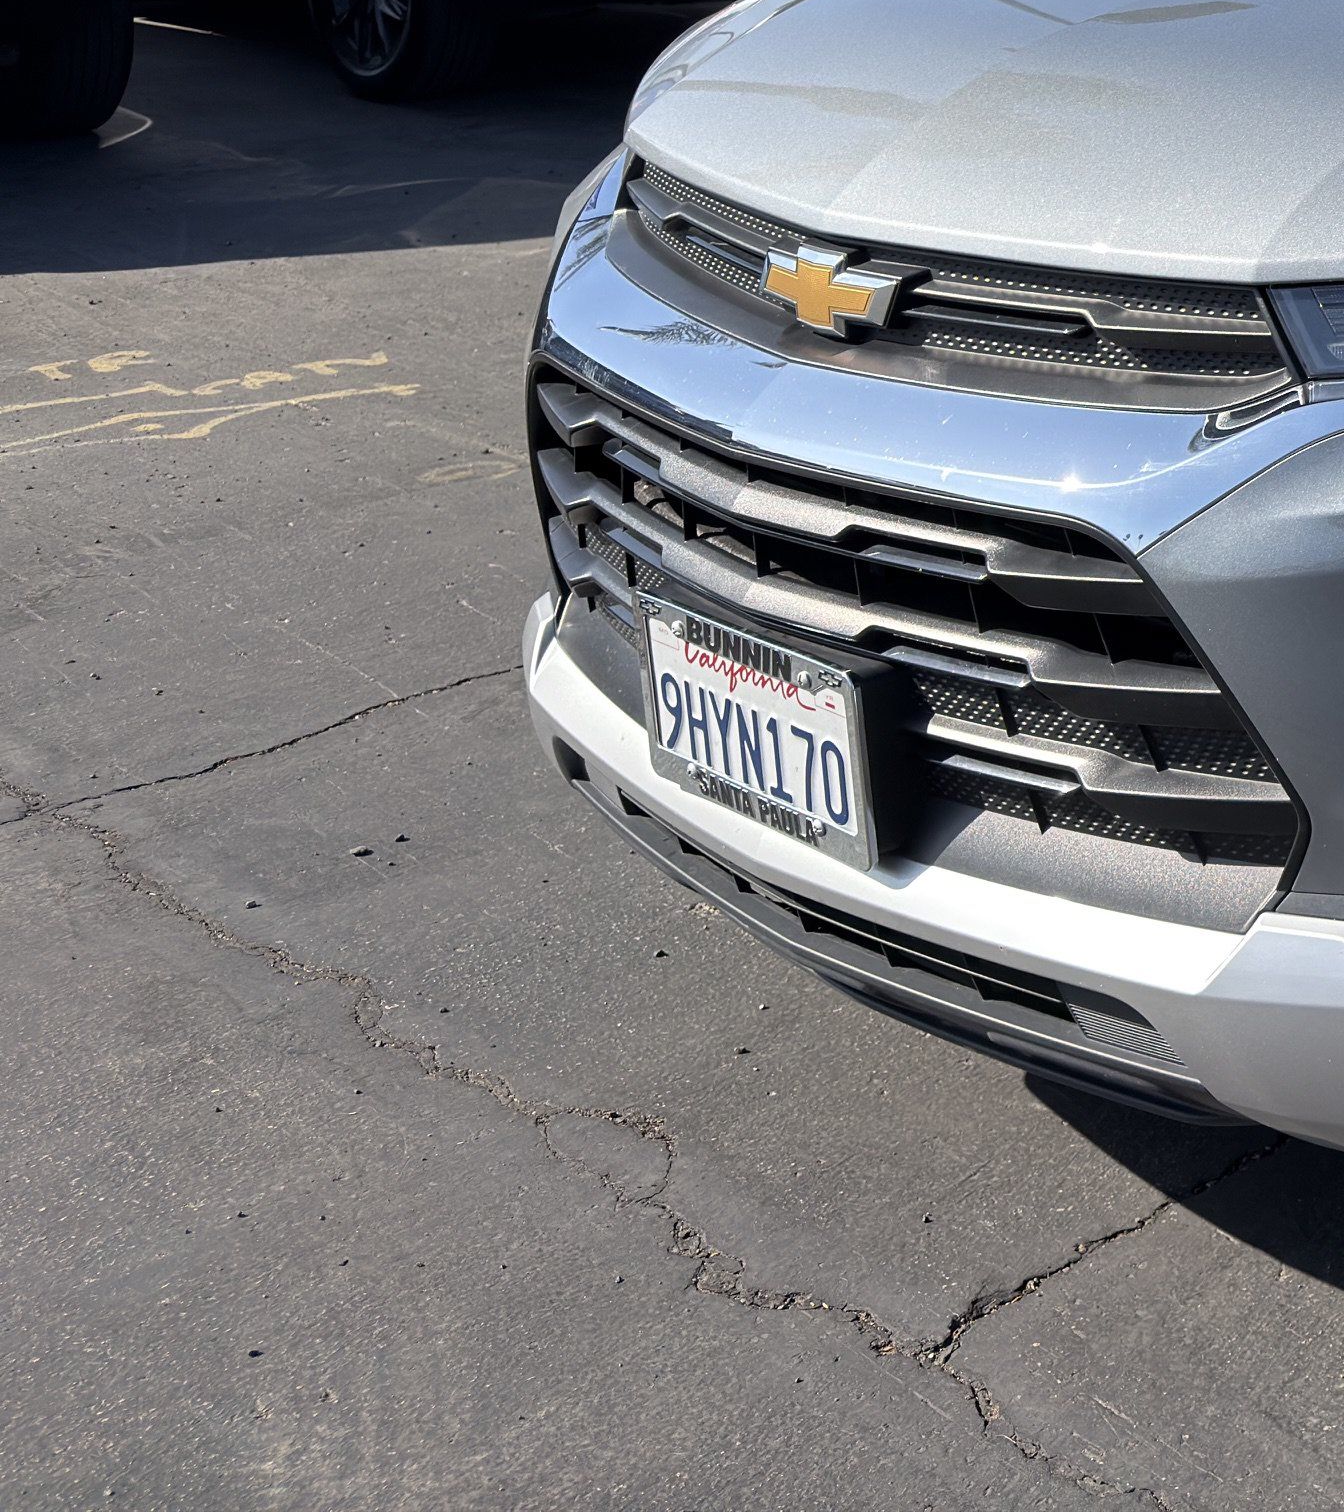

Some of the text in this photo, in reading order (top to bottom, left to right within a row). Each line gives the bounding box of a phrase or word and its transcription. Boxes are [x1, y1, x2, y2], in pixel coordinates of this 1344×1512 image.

[683, 640, 816, 712] California
[684, 614, 794, 683] BUNNIN
[660, 672, 850, 826] 9HYN170
[697, 769, 821, 848] SANTA PAULA
